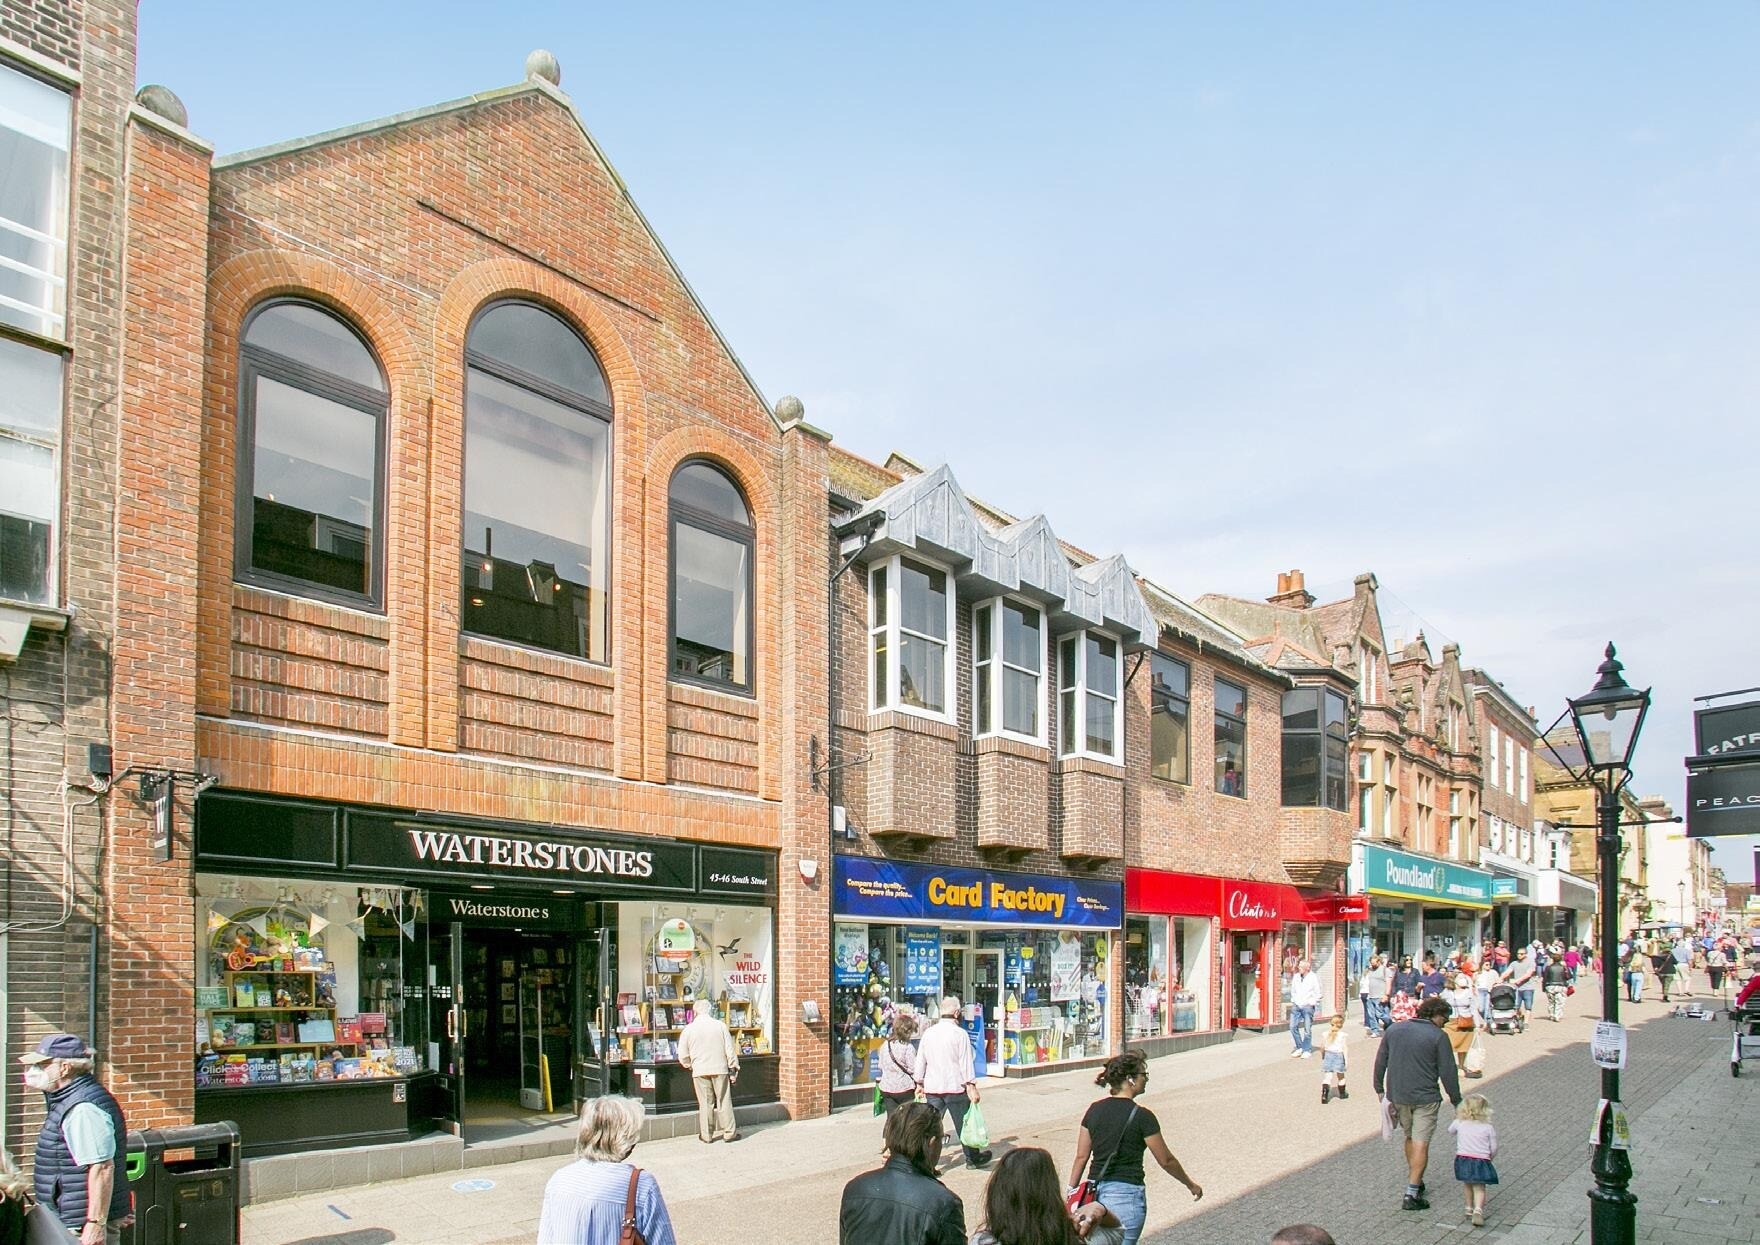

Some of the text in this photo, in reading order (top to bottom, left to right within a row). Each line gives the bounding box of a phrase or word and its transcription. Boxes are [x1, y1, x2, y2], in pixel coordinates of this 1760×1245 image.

[408, 830, 652, 877] WATERSTONES
[710, 873, 768, 885] 45-46 South Street
[1386, 858, 1434, 889] Poundland
[847, 879, 872, 887] Compare
[859, 887, 884, 896] Compare
[928, 877, 1065, 918] Card Factory
[736, 961, 761, 971] WILD
[729, 973, 767, 985] SILENCE
[396, 1058, 414, 1066] 2021
[200, 1065, 227, 1075] Click
[240, 1062, 277, 1072] Collect
